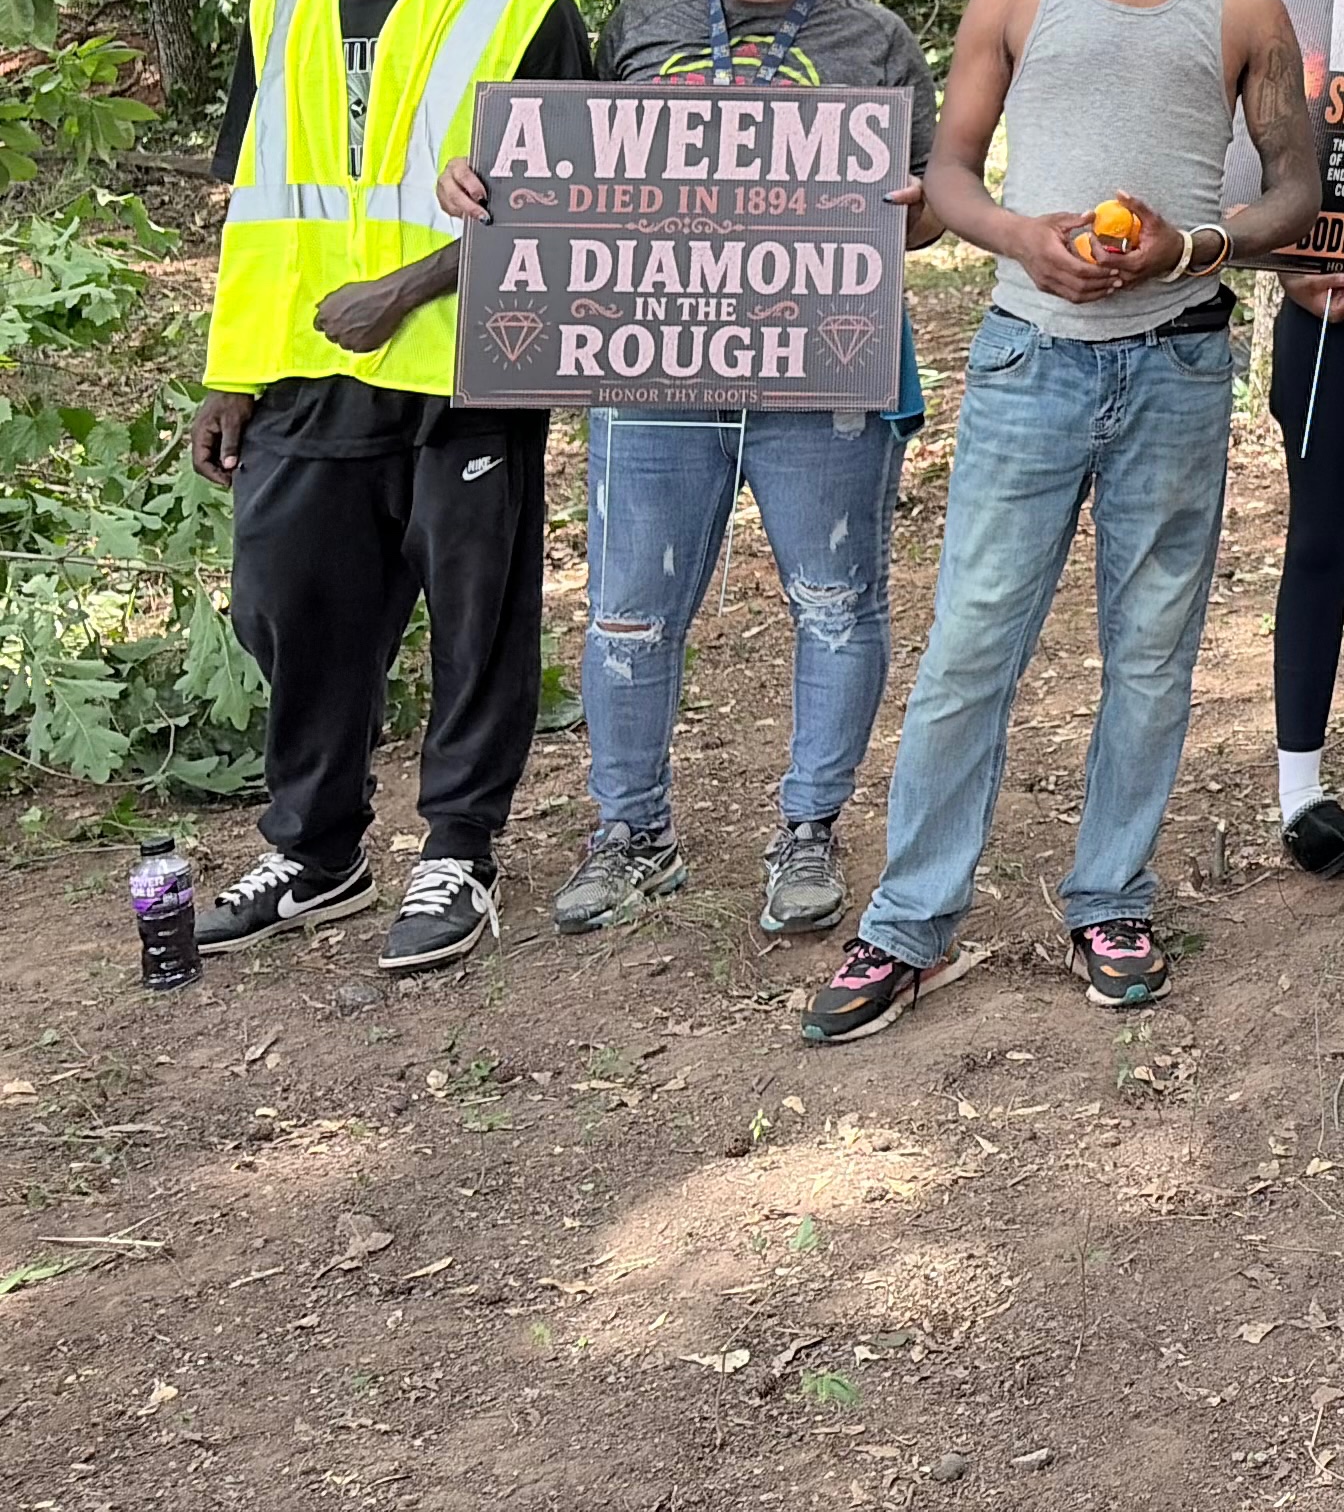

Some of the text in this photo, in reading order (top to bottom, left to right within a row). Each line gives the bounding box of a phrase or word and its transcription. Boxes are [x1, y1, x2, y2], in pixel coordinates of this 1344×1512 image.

[490, 98, 890, 183] A. WEEMS
[1329, 153, 1343, 167] OF
[568, 185, 807, 215] DIED IN 1894
[499, 239, 883, 296] A DIAMOND
[634, 297, 737, 322] IN THE
[556, 324, 809, 378] ROUGH
[599, 388, 759, 403] HONOR THY ROOTS
